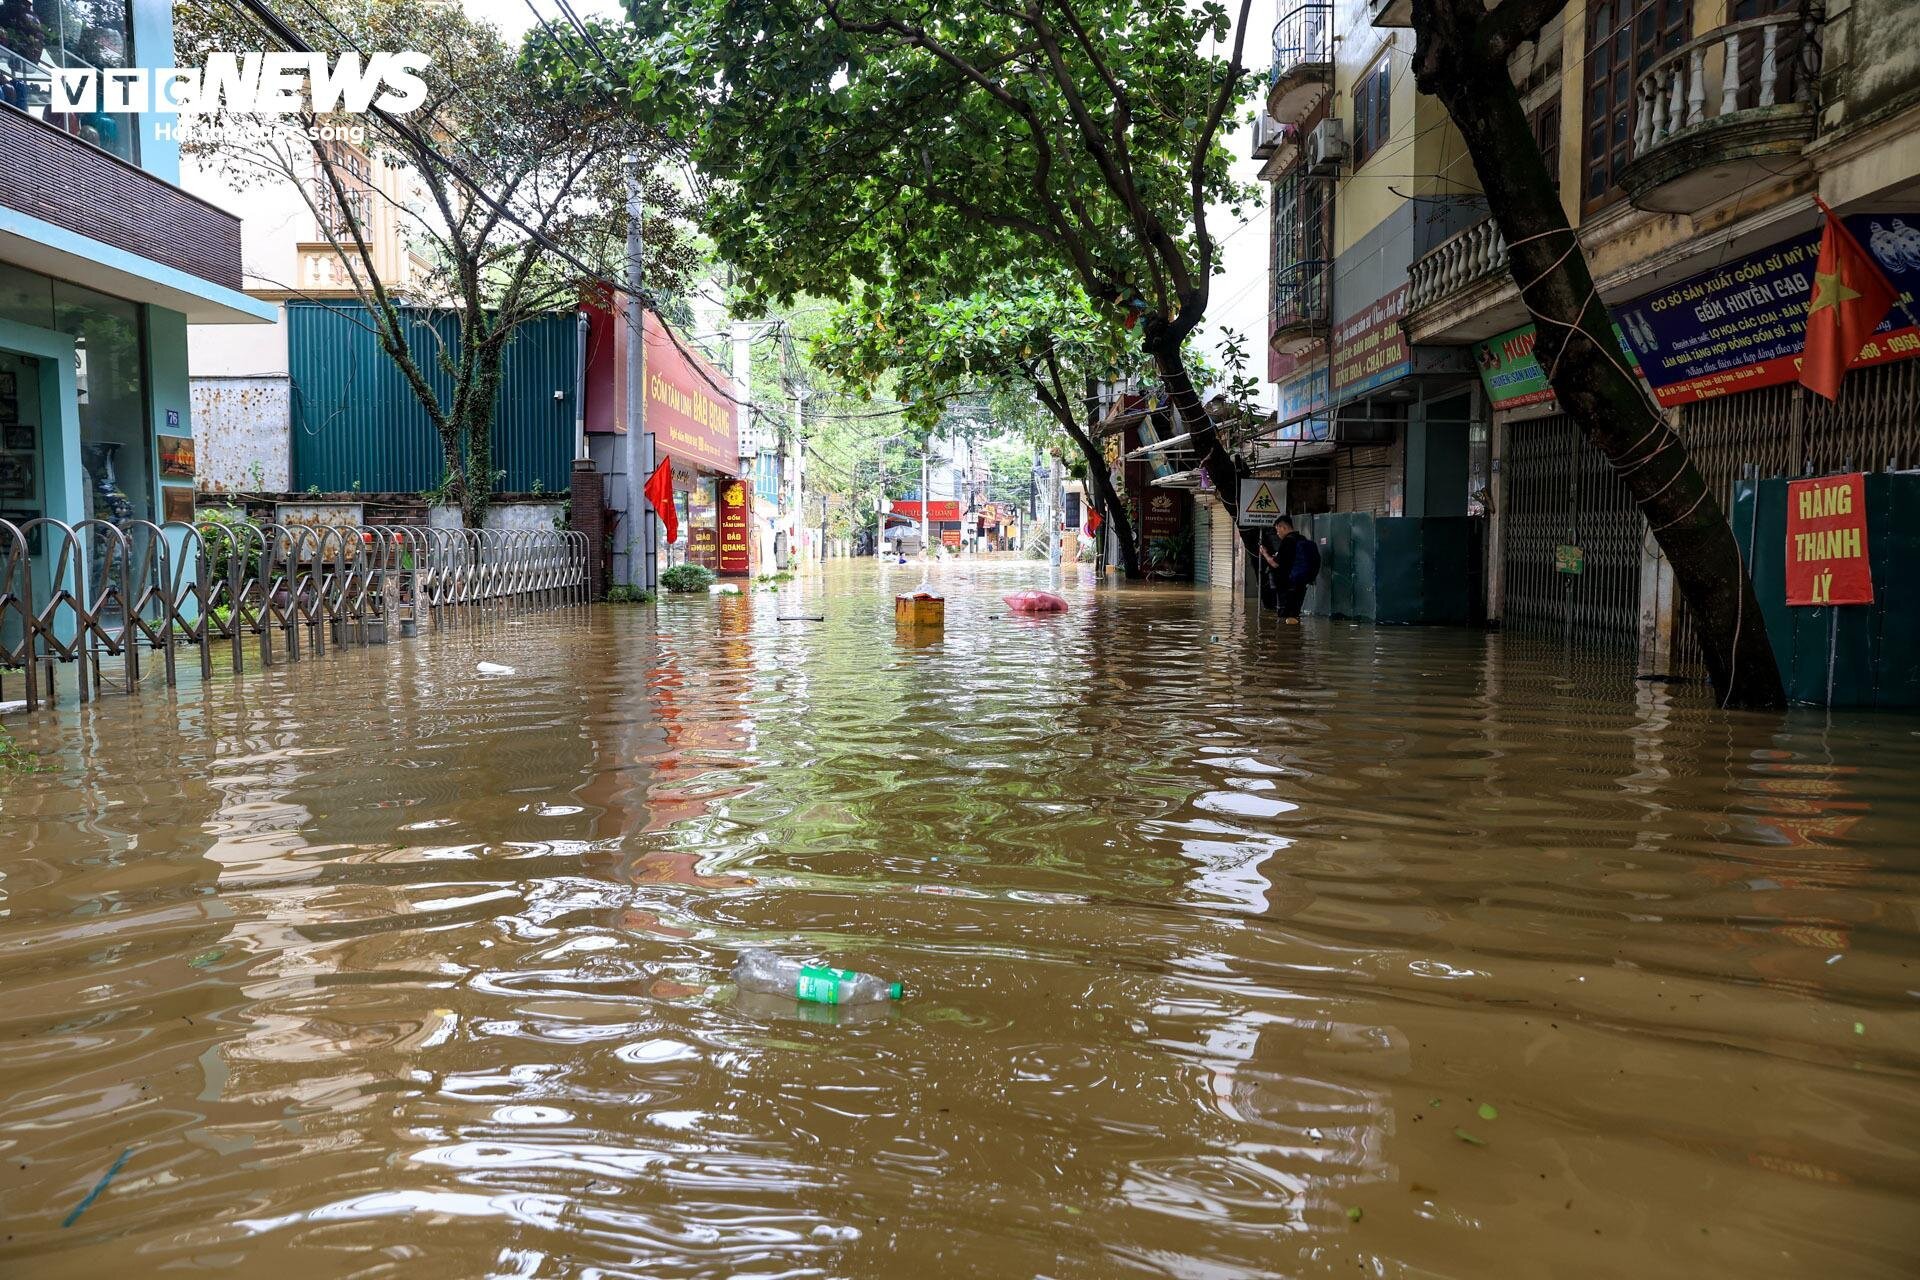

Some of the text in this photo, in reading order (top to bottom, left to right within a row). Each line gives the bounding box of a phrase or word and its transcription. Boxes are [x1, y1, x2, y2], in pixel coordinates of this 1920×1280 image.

[1704, 271, 1734, 293] XUẤT
[1734, 261, 1766, 283] GỐM
[1765, 253, 1783, 272] SỨ
[1782, 246, 1805, 266] MỸ
[1694, 272, 1810, 322] GỐM HUYỀN CAO
[1719, 320, 1740, 336] HOA
[1737, 315, 1758, 332] CÁC
[1756, 310, 1779, 326] LOẠI
[1782, 302, 1803, 318] BÁN
[1728, 334, 1753, 351] ĐỒNG
[1751, 327, 1776, 344] GỐM
[1773, 323, 1787, 338] SỨ
[651, 371, 668, 406] GỐM
[168, 411, 178, 425] 76
[1799, 482, 1852, 520] HÀNG
[722, 543, 746, 552] QUANG
[1794, 527, 1862, 562] THANH
[1811, 567, 1833, 603] LÝ
